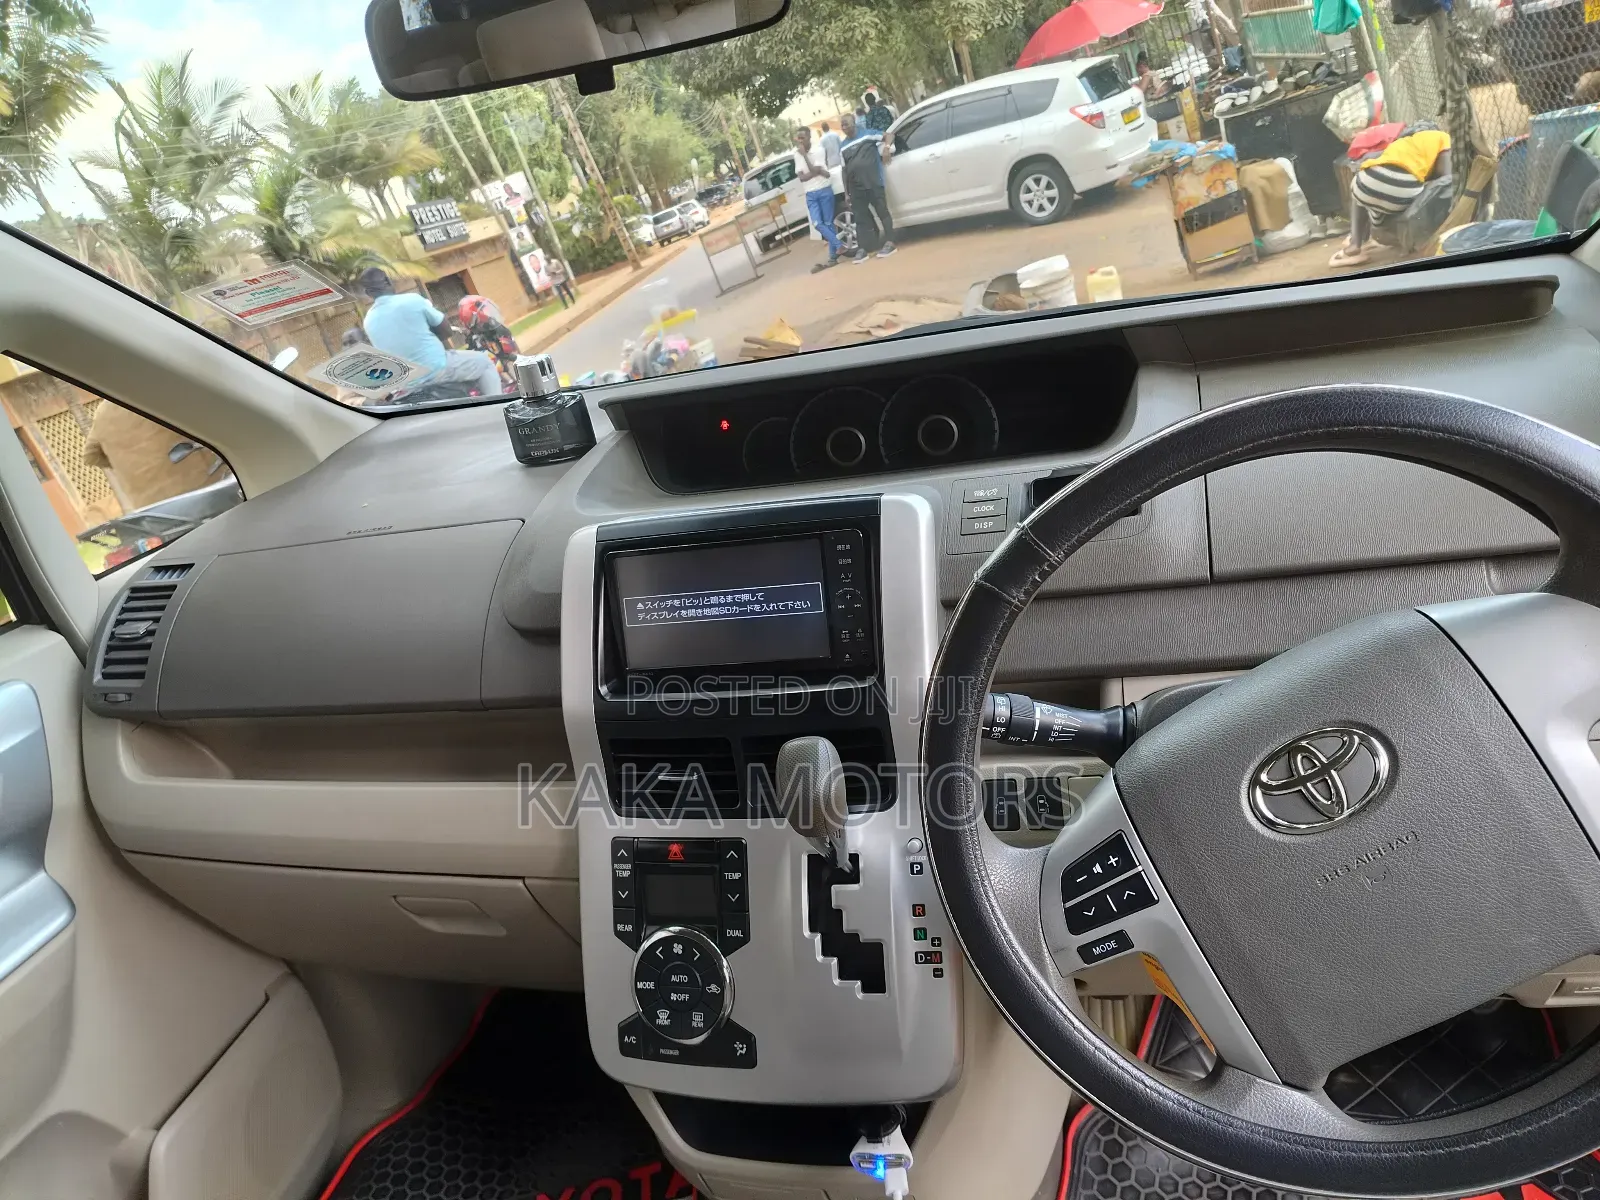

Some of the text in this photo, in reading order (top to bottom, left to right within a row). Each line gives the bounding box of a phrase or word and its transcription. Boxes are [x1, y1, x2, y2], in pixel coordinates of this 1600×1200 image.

[411, 201, 461, 225] PRESTIGE
[518, 422, 560, 435] GRANDY
[913, 864, 921, 873] P
[616, 870, 631, 878] TEMP
[724, 872, 741, 880] TEMP
[915, 906, 923, 915] R
[617, 924, 633, 932] REAR
[726, 929, 744, 937] DUAL
[916, 930, 925, 939] N
[1092, 940, 1118, 956] MODE
[670, 974, 688, 983] AUTO
[637, 981, 655, 990] MODE
[677, 993, 690, 1002] OFF
[656, 1018, 671, 1026] FRONT
[691, 1020, 704, 1028] REAR
[624, 1035, 637, 1044] A/C
